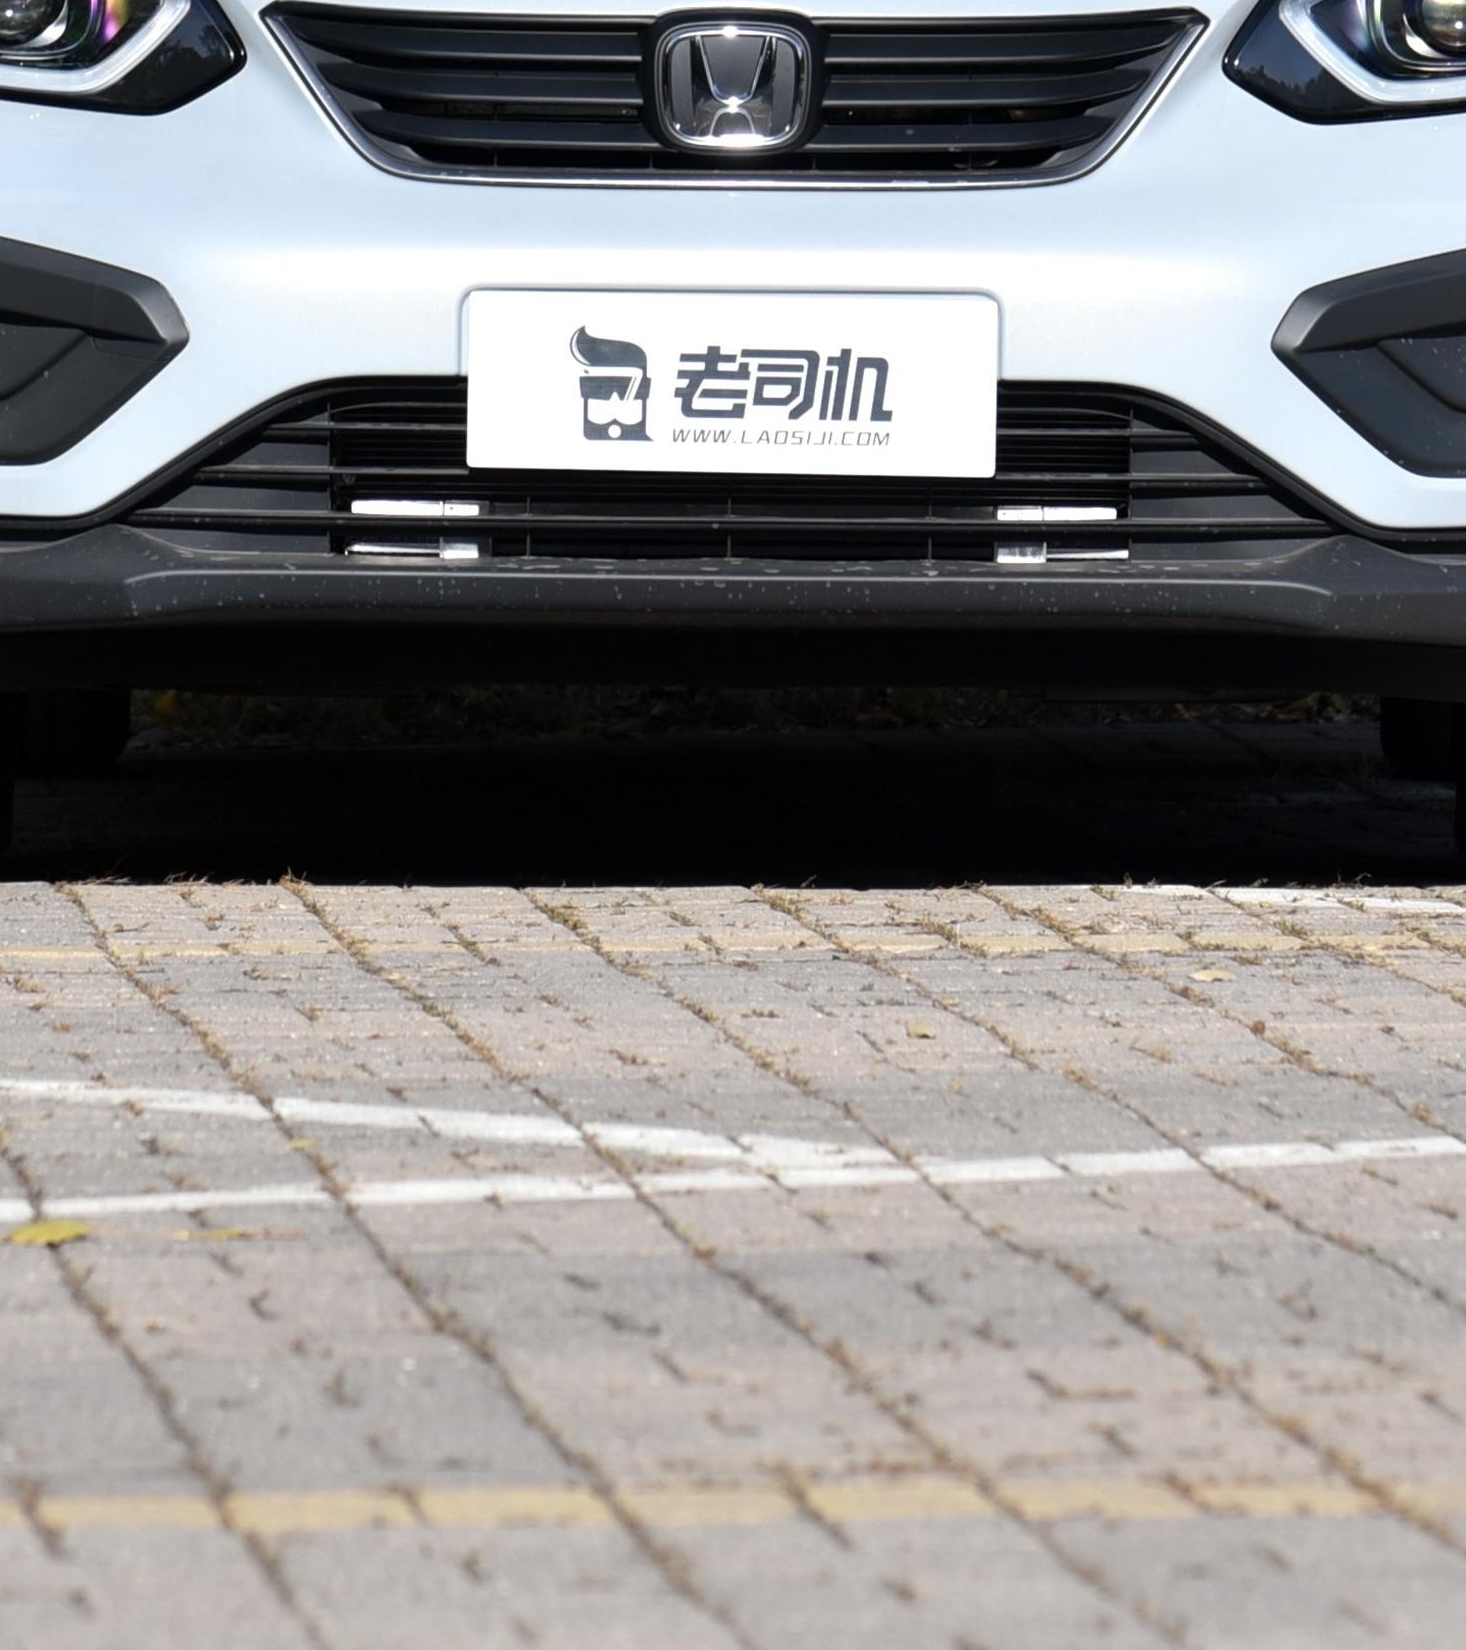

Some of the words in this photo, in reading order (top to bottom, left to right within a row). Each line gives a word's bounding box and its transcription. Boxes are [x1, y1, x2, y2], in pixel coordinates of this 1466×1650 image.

[673, 345, 893, 422] 老司机
[672, 428, 891, 447] WWW.LAOSIJI.COM
